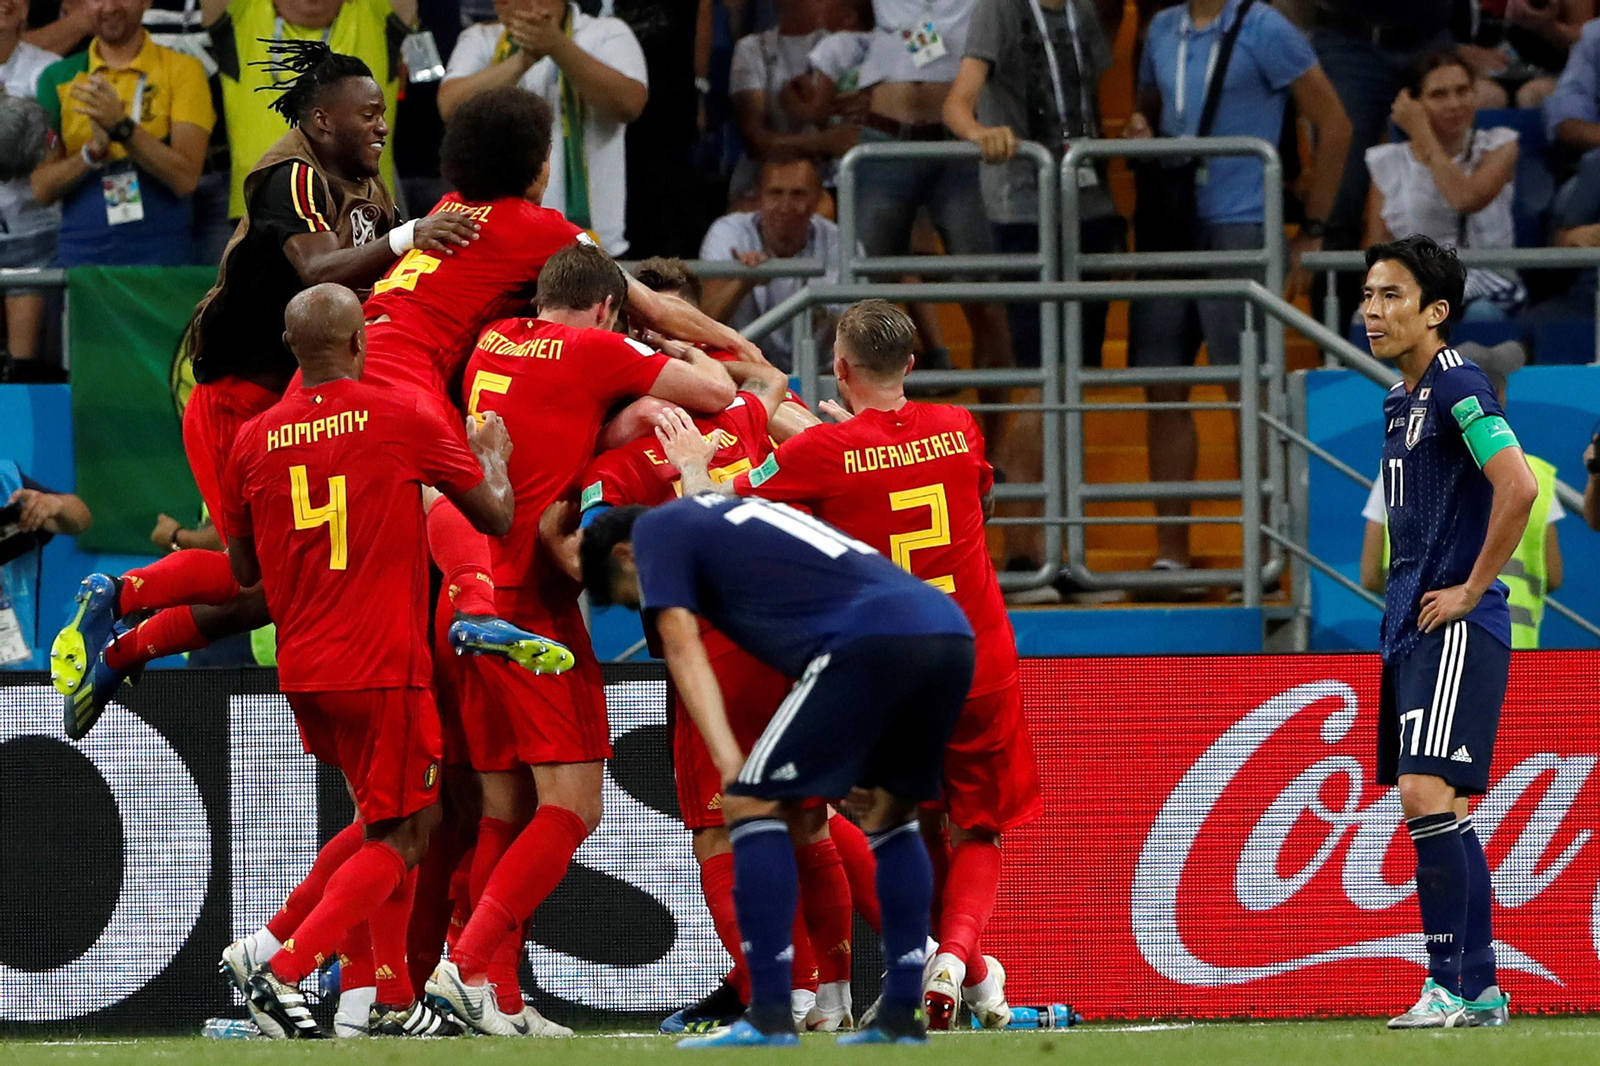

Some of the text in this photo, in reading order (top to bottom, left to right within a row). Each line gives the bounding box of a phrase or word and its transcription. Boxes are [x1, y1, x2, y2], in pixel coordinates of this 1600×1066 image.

[267, 410, 368, 451] KOMPANY
[843, 431, 969, 474] ALDERWEIRELD
[289, 465, 348, 570] 4
[889, 482, 956, 594] 2
